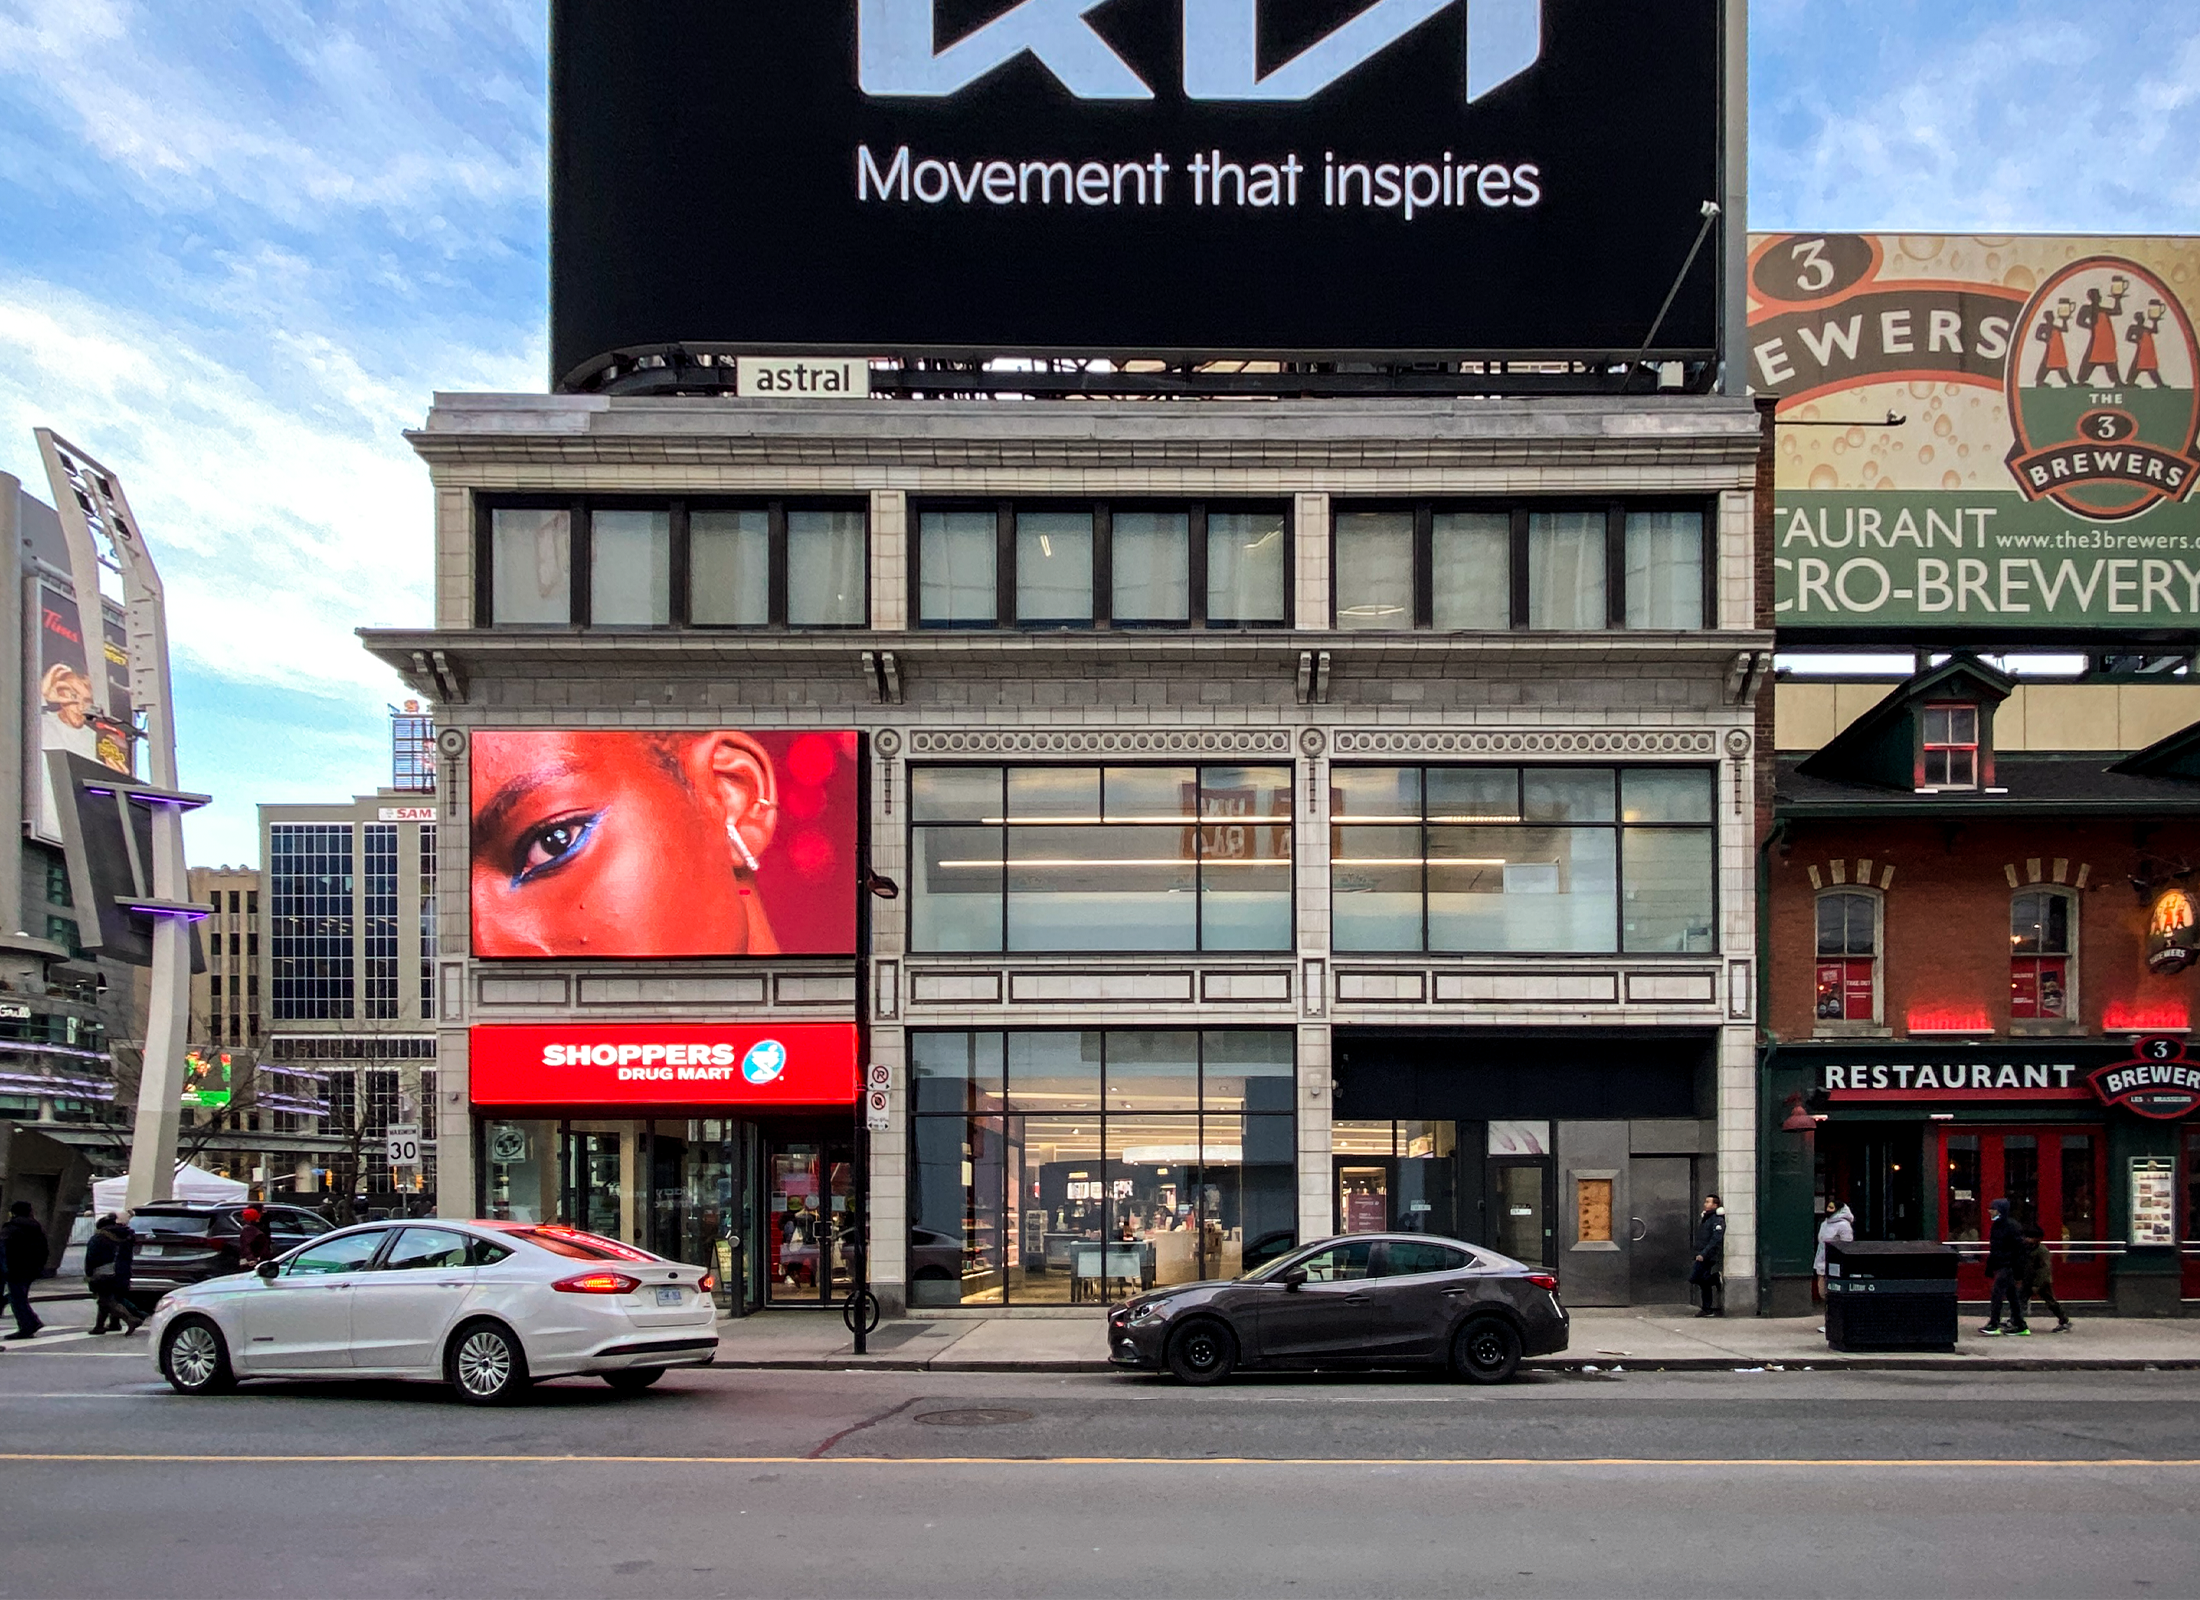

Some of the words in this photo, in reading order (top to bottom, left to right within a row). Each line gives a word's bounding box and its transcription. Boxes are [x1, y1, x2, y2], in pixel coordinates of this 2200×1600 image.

[857, 145, 1170, 204] Movement
[1186, 149, 1303, 205] that
[1324, 151, 1541, 220] inspires
[1791, 238, 1835, 291] 3
[1746, 310, 2009, 396] EWERS
[757, 363, 849, 391] astral
[2089, 393, 2123, 404] THE
[2098, 416, 2116, 438] 3
[2029, 451, 2184, 487] BREWERS
[542, 1044, 735, 1066] SHOPPERS
[2153, 1041, 2168, 1058] 3
[618, 1067, 673, 1080] DRUG
[677, 1067, 734, 1080] MART
[1825, 1065, 2076, 1089] RESTAURANT
[390, 1142, 416, 1160] 30
